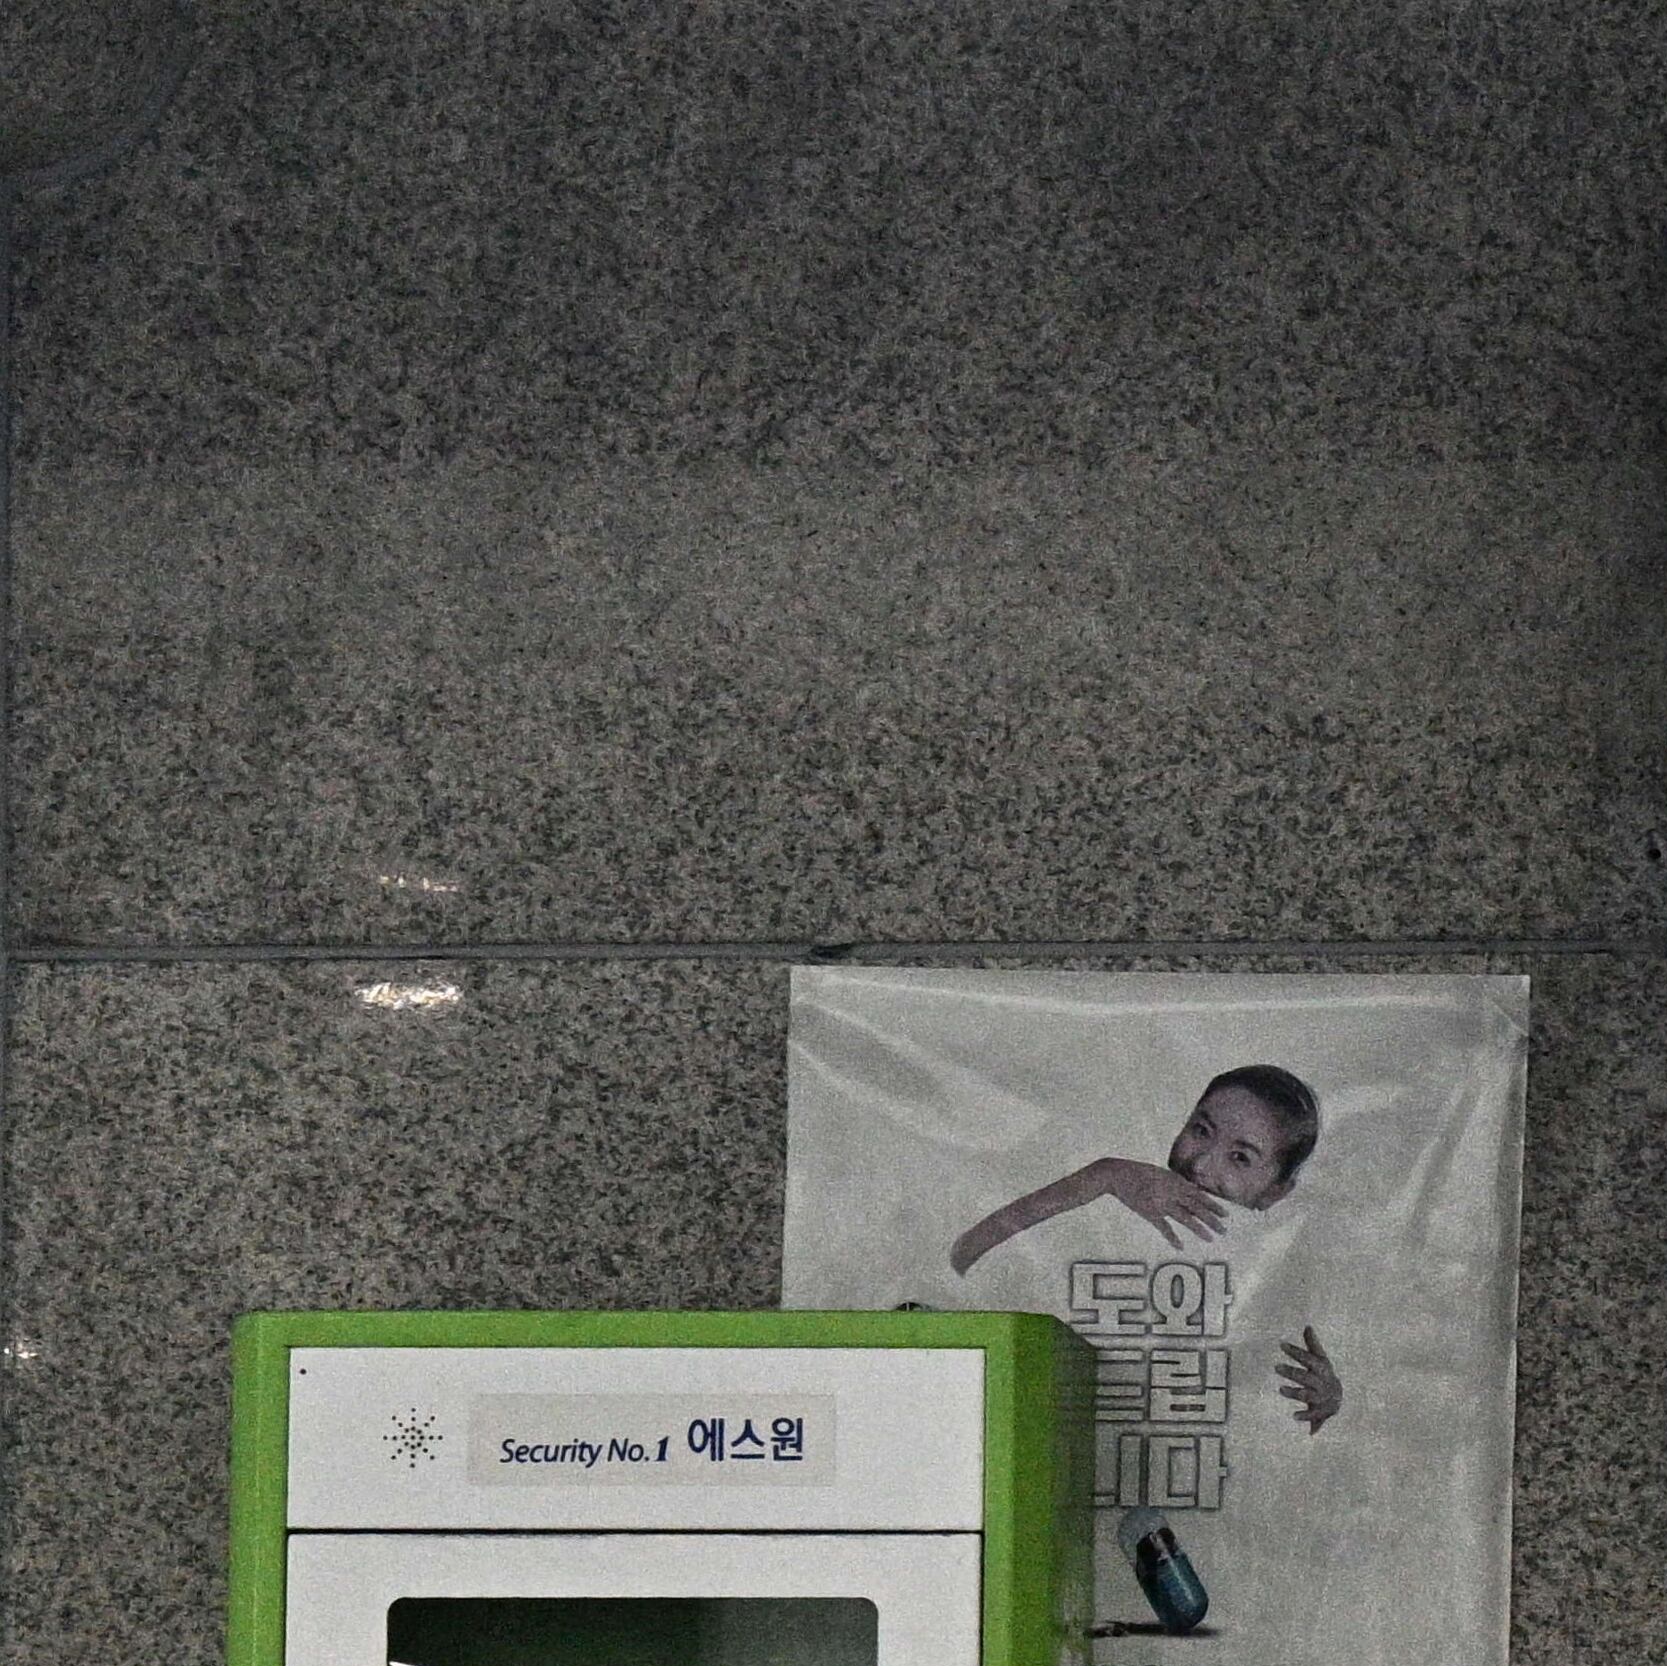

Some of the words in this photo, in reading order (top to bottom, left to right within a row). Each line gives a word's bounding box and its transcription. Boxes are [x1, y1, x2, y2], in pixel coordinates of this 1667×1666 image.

[500, 1438, 603, 1469] Security
[607, 1436, 669, 1463] No.1
[687, 1417, 803, 1462] 에스원
